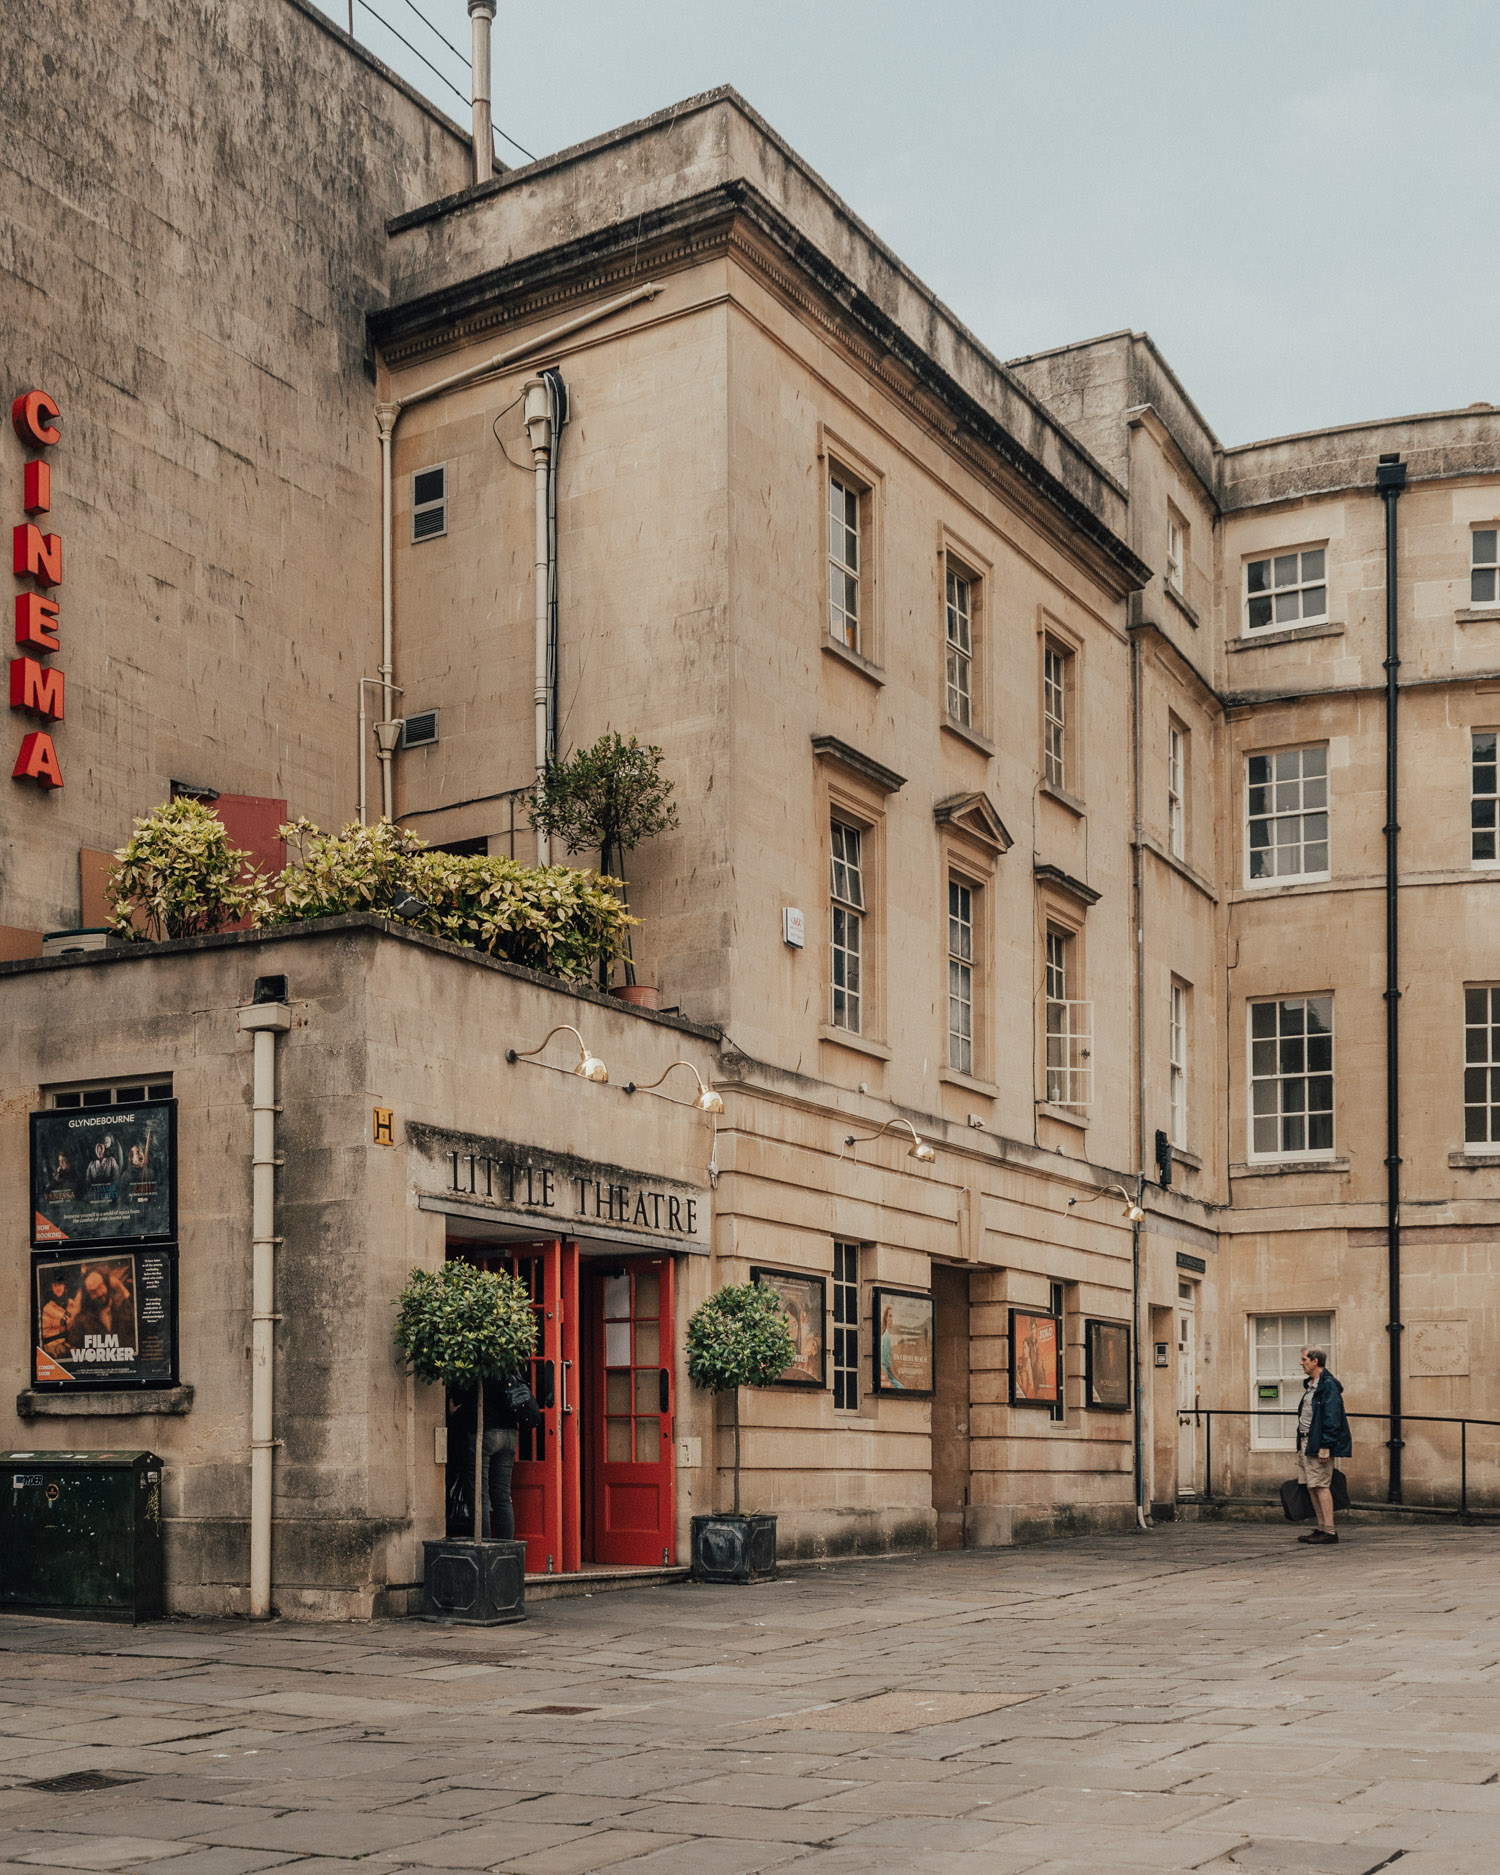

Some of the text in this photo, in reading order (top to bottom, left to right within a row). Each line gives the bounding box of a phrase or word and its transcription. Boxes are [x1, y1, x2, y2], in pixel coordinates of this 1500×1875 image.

[10, 389, 64, 790] CINEMA
[68, 1114, 135, 1128] GLYNDEBOURNE
[376, 1110, 392, 1142] H
[43, 1191, 76, 1201] VANESSA
[450, 1150, 698, 1234] LITTLE THEATRE
[36, 1231, 61, 1239] BOOKING
[1039, 1327, 1053, 1340] SOLO
[84, 1334, 120, 1348] FILM
[70, 1347, 135, 1362] WORKER
